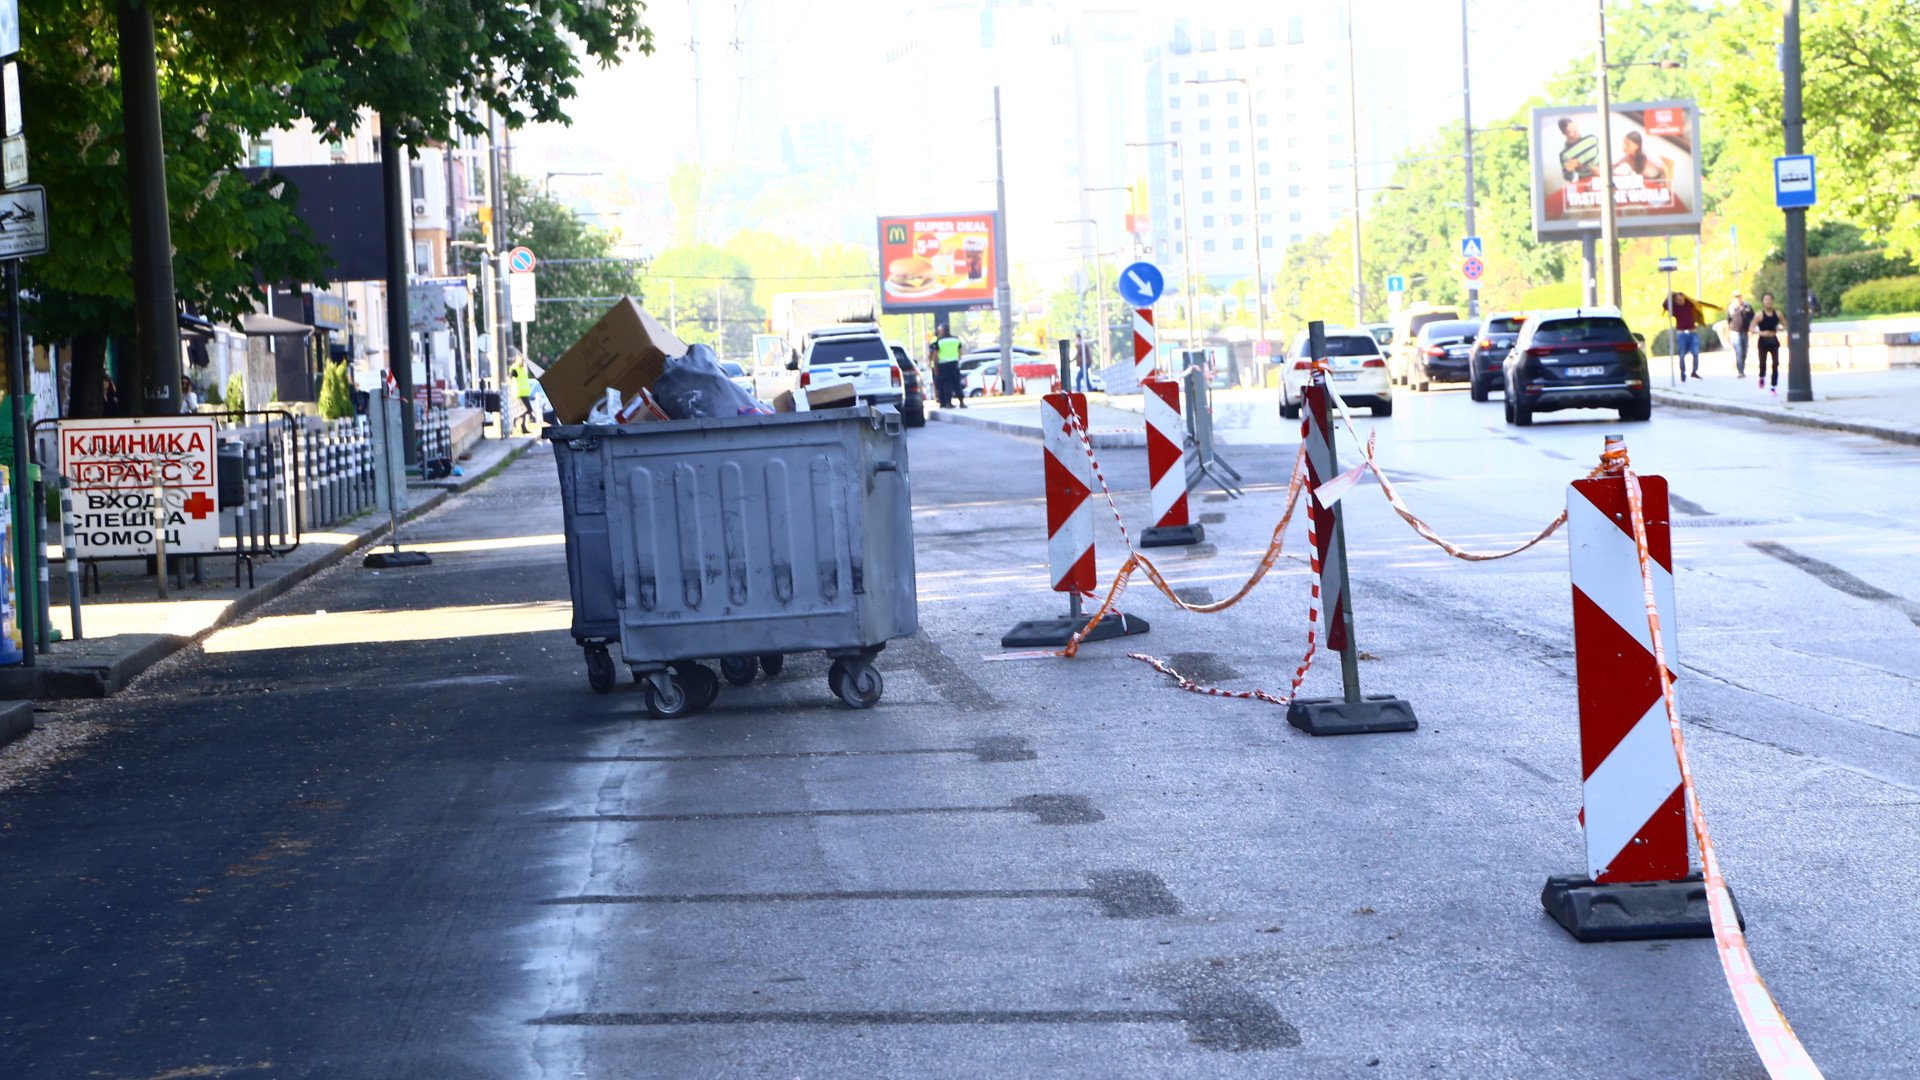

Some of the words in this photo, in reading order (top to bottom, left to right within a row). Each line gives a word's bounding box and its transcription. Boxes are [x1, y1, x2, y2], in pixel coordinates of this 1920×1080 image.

[1629, 188, 1670, 204] WORLD
[914, 222, 953, 232] SUPER
[957, 222, 988, 232] DEAL
[70, 432, 205, 456] КЛИНИКА
[71, 462, 182, 483] ТОРАКС
[192, 461, 206, 480] 2
[89, 493, 157, 510] ВХОД
